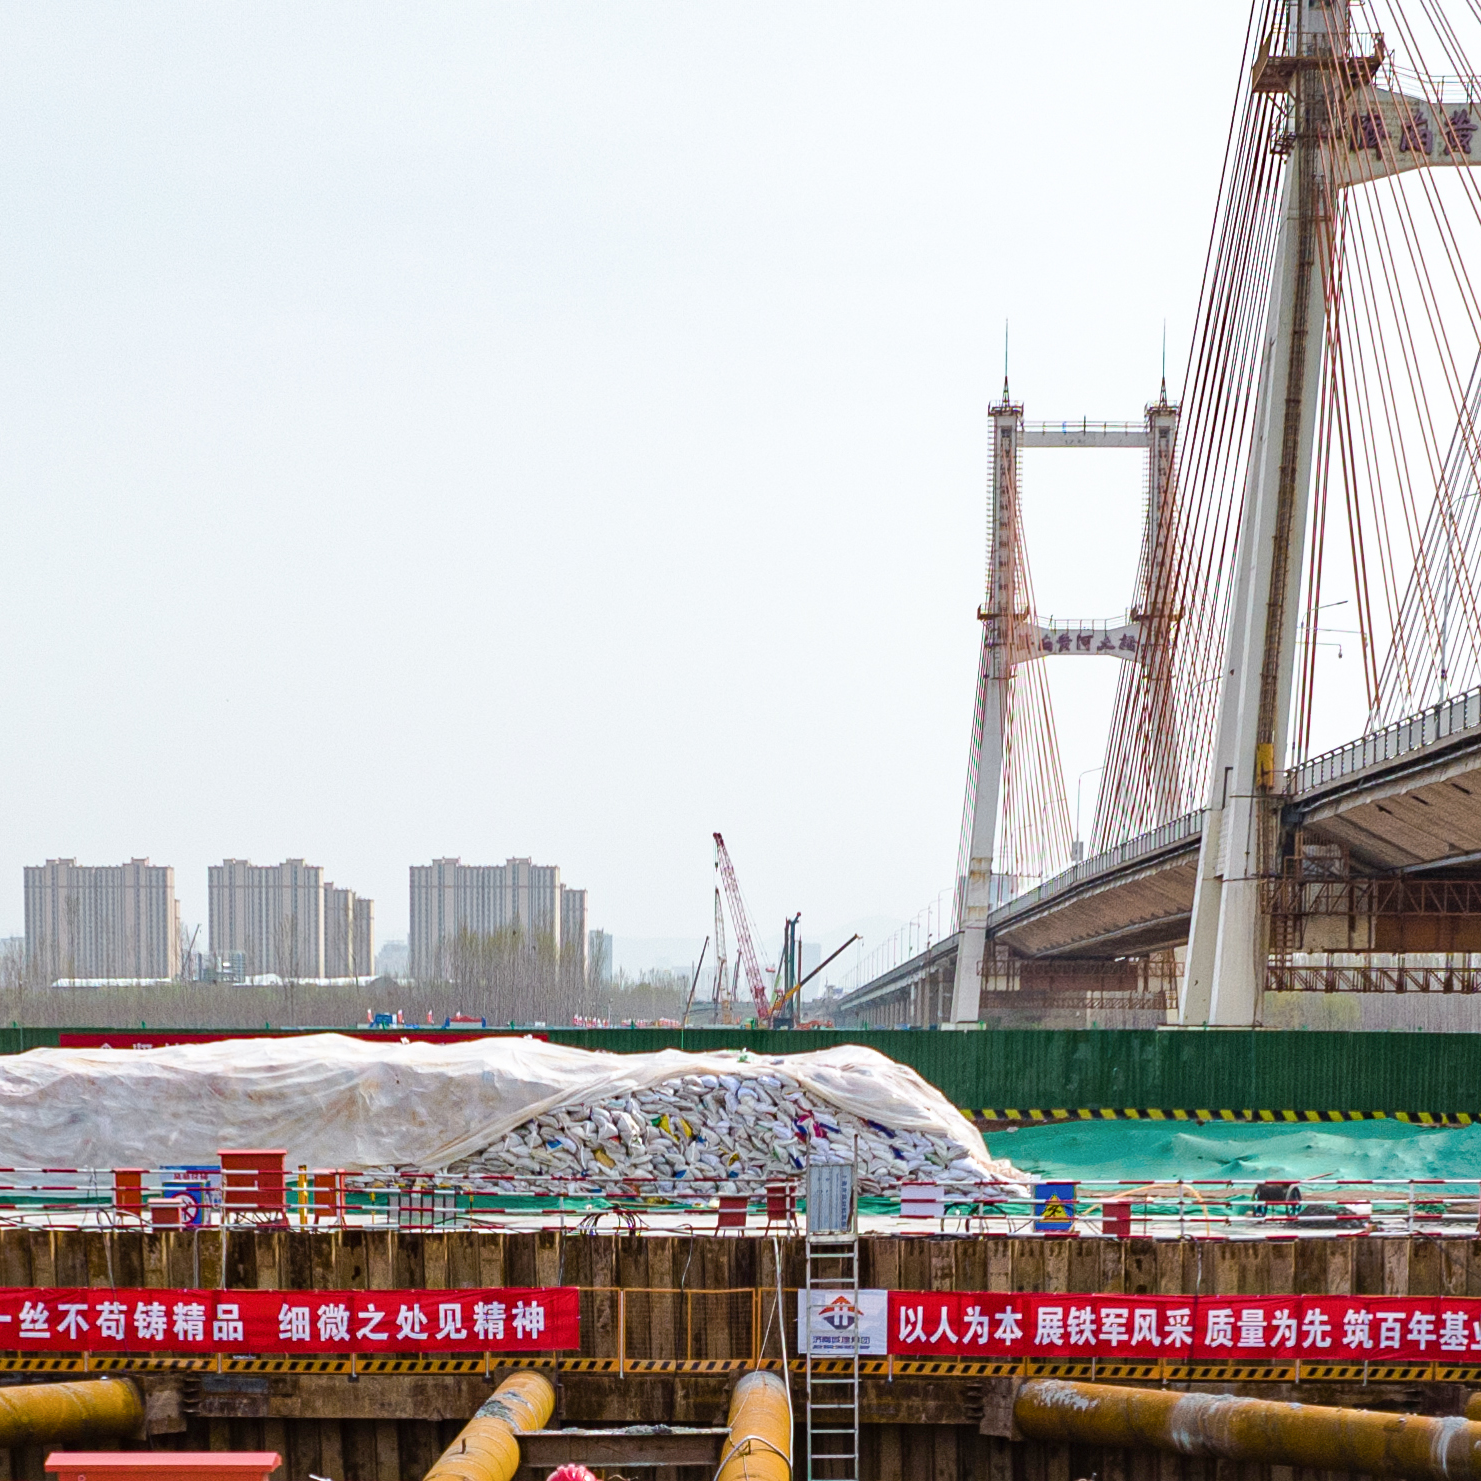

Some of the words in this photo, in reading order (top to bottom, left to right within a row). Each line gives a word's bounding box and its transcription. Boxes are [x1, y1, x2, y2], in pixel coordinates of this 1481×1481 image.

[278, 1302, 546, 1341] 细微之处见精神
[898, 1306, 1023, 1345] 以人为本
[1034, 1306, 1193, 1347] 展铁军风采
[1204, 1308, 1332, 1349] 质量为先
